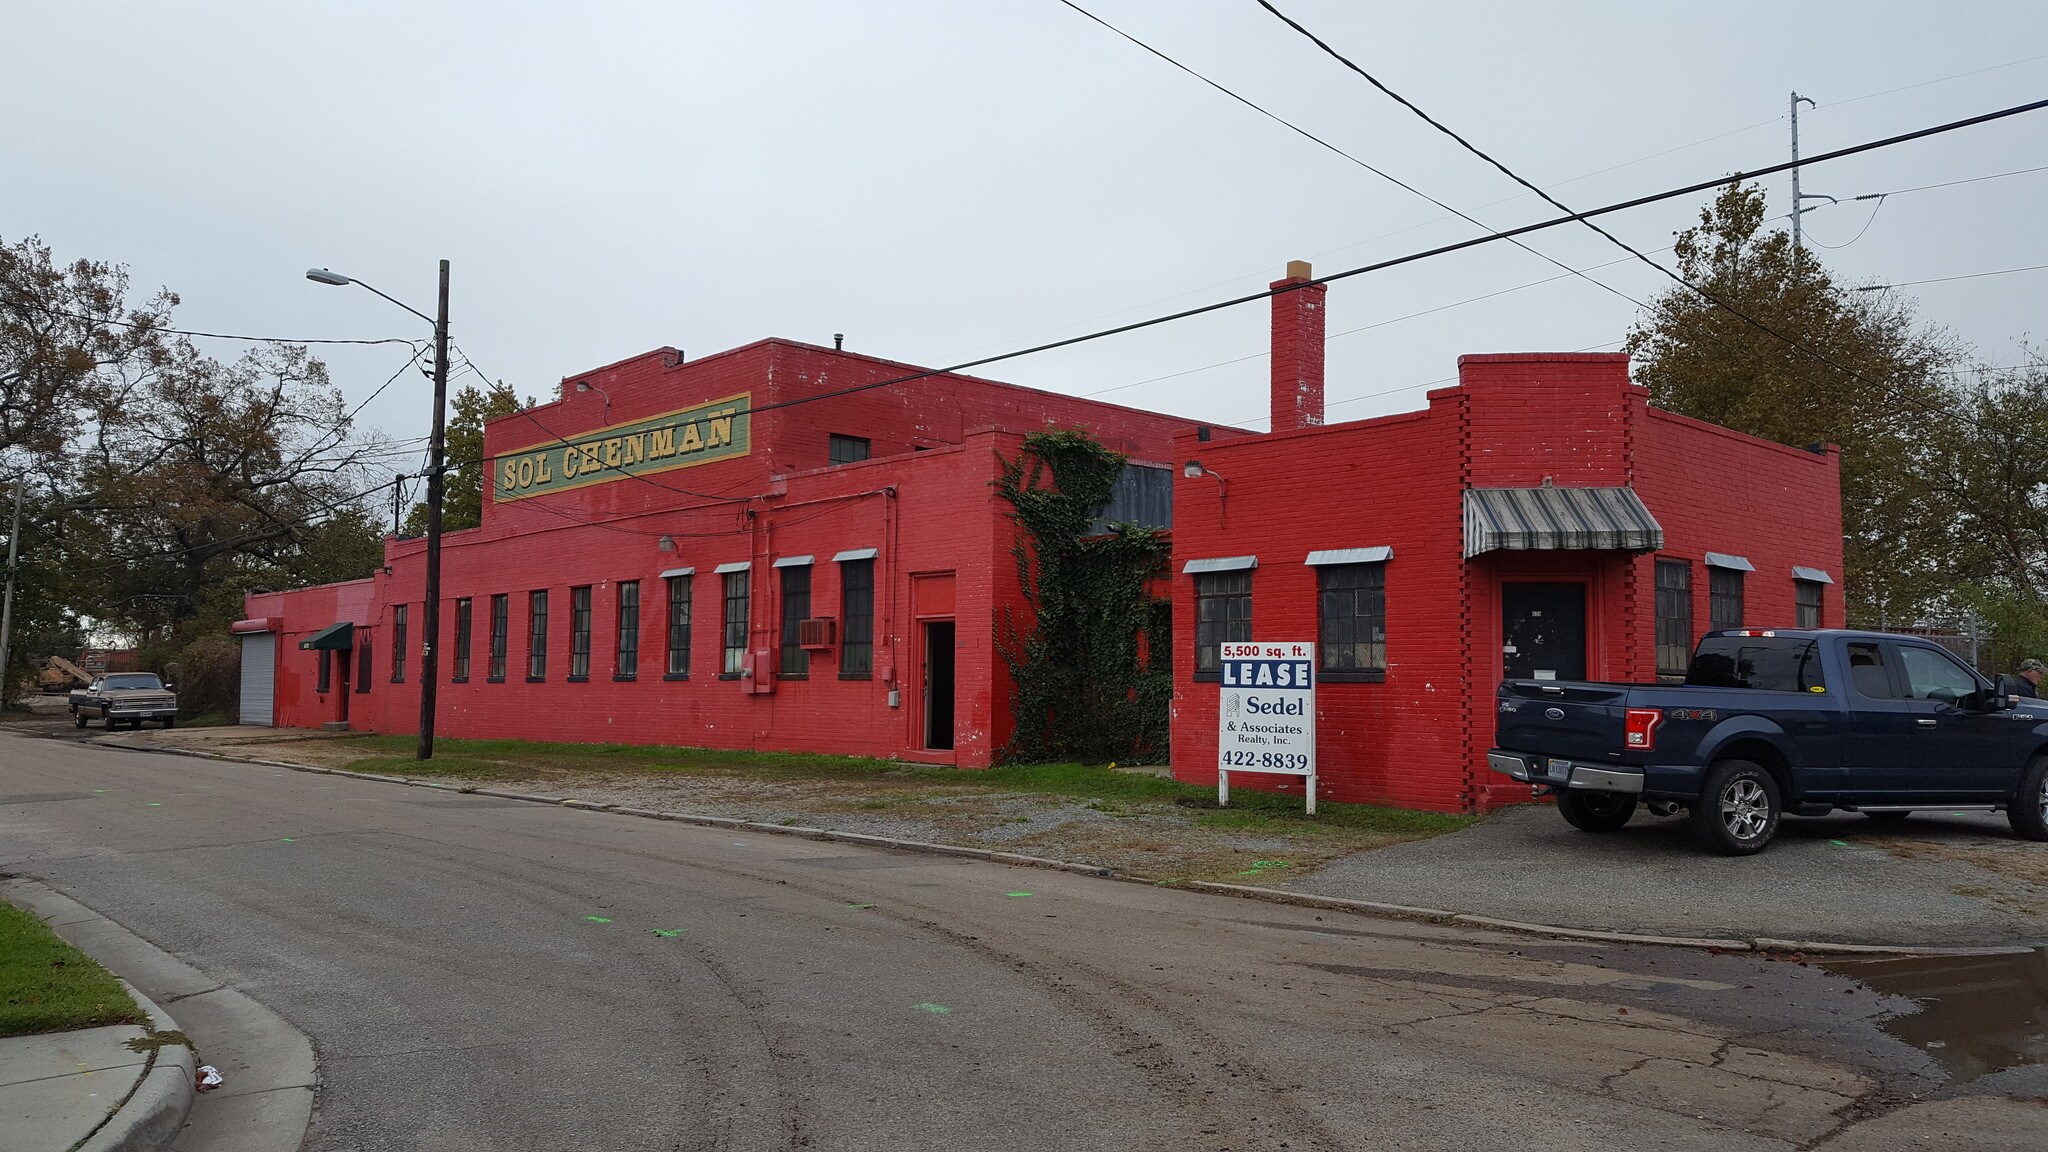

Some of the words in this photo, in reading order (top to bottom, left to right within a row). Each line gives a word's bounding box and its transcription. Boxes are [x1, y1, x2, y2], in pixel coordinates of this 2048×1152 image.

[504, 453, 553, 491] SOL
[562, 407, 737, 480] CHENMAN
[1224, 645, 1260, 658] 5,500
[1266, 647, 1286, 659] sq.
[1291, 645, 1307, 657] ft.
[1223, 662, 1308, 686] LEASE
[1246, 696, 1304, 716] Sedel
[1227, 720, 1237, 732] &
[1240, 721, 1303, 735] Associates
[1238, 734, 1270, 746] Realty,
[1273, 735, 1291, 745] Inc.
[1222, 750, 1308, 770] 422-8839
